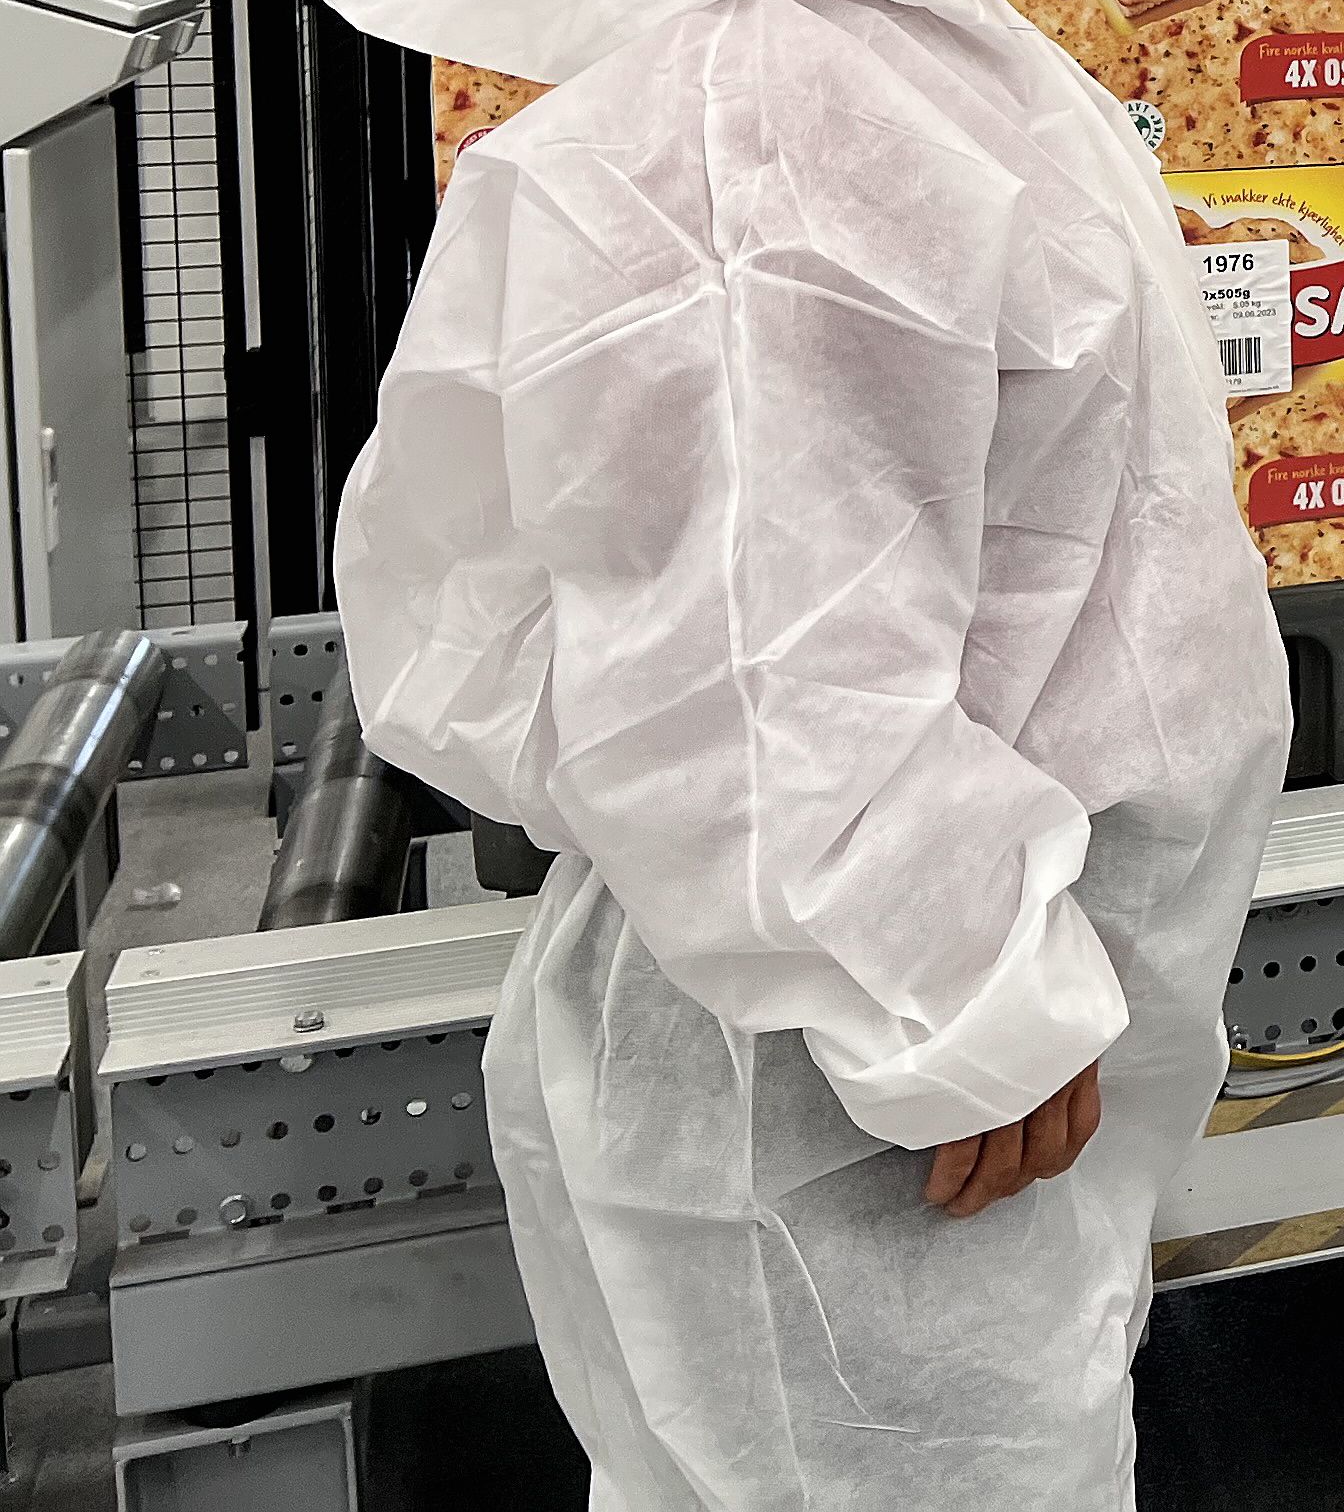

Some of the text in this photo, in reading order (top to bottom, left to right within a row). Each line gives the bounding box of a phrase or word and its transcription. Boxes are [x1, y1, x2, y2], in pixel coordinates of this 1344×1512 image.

[1260, 44, 1280, 59] Fire
[1284, 42, 1318, 56] norske
[1285, 60, 1317, 87] 4X
[1128, 103, 1149, 112] AVT
[1203, 194, 1217, 208] Vi
[1221, 189, 1268, 205] snakker
[1272, 193, 1296, 209] ekte
[1203, 254, 1254, 273] 1976
[1268, 468, 1288, 484] Fire
[1292, 464, 1325, 479] norske
[1293, 481, 1325, 510] 4X
